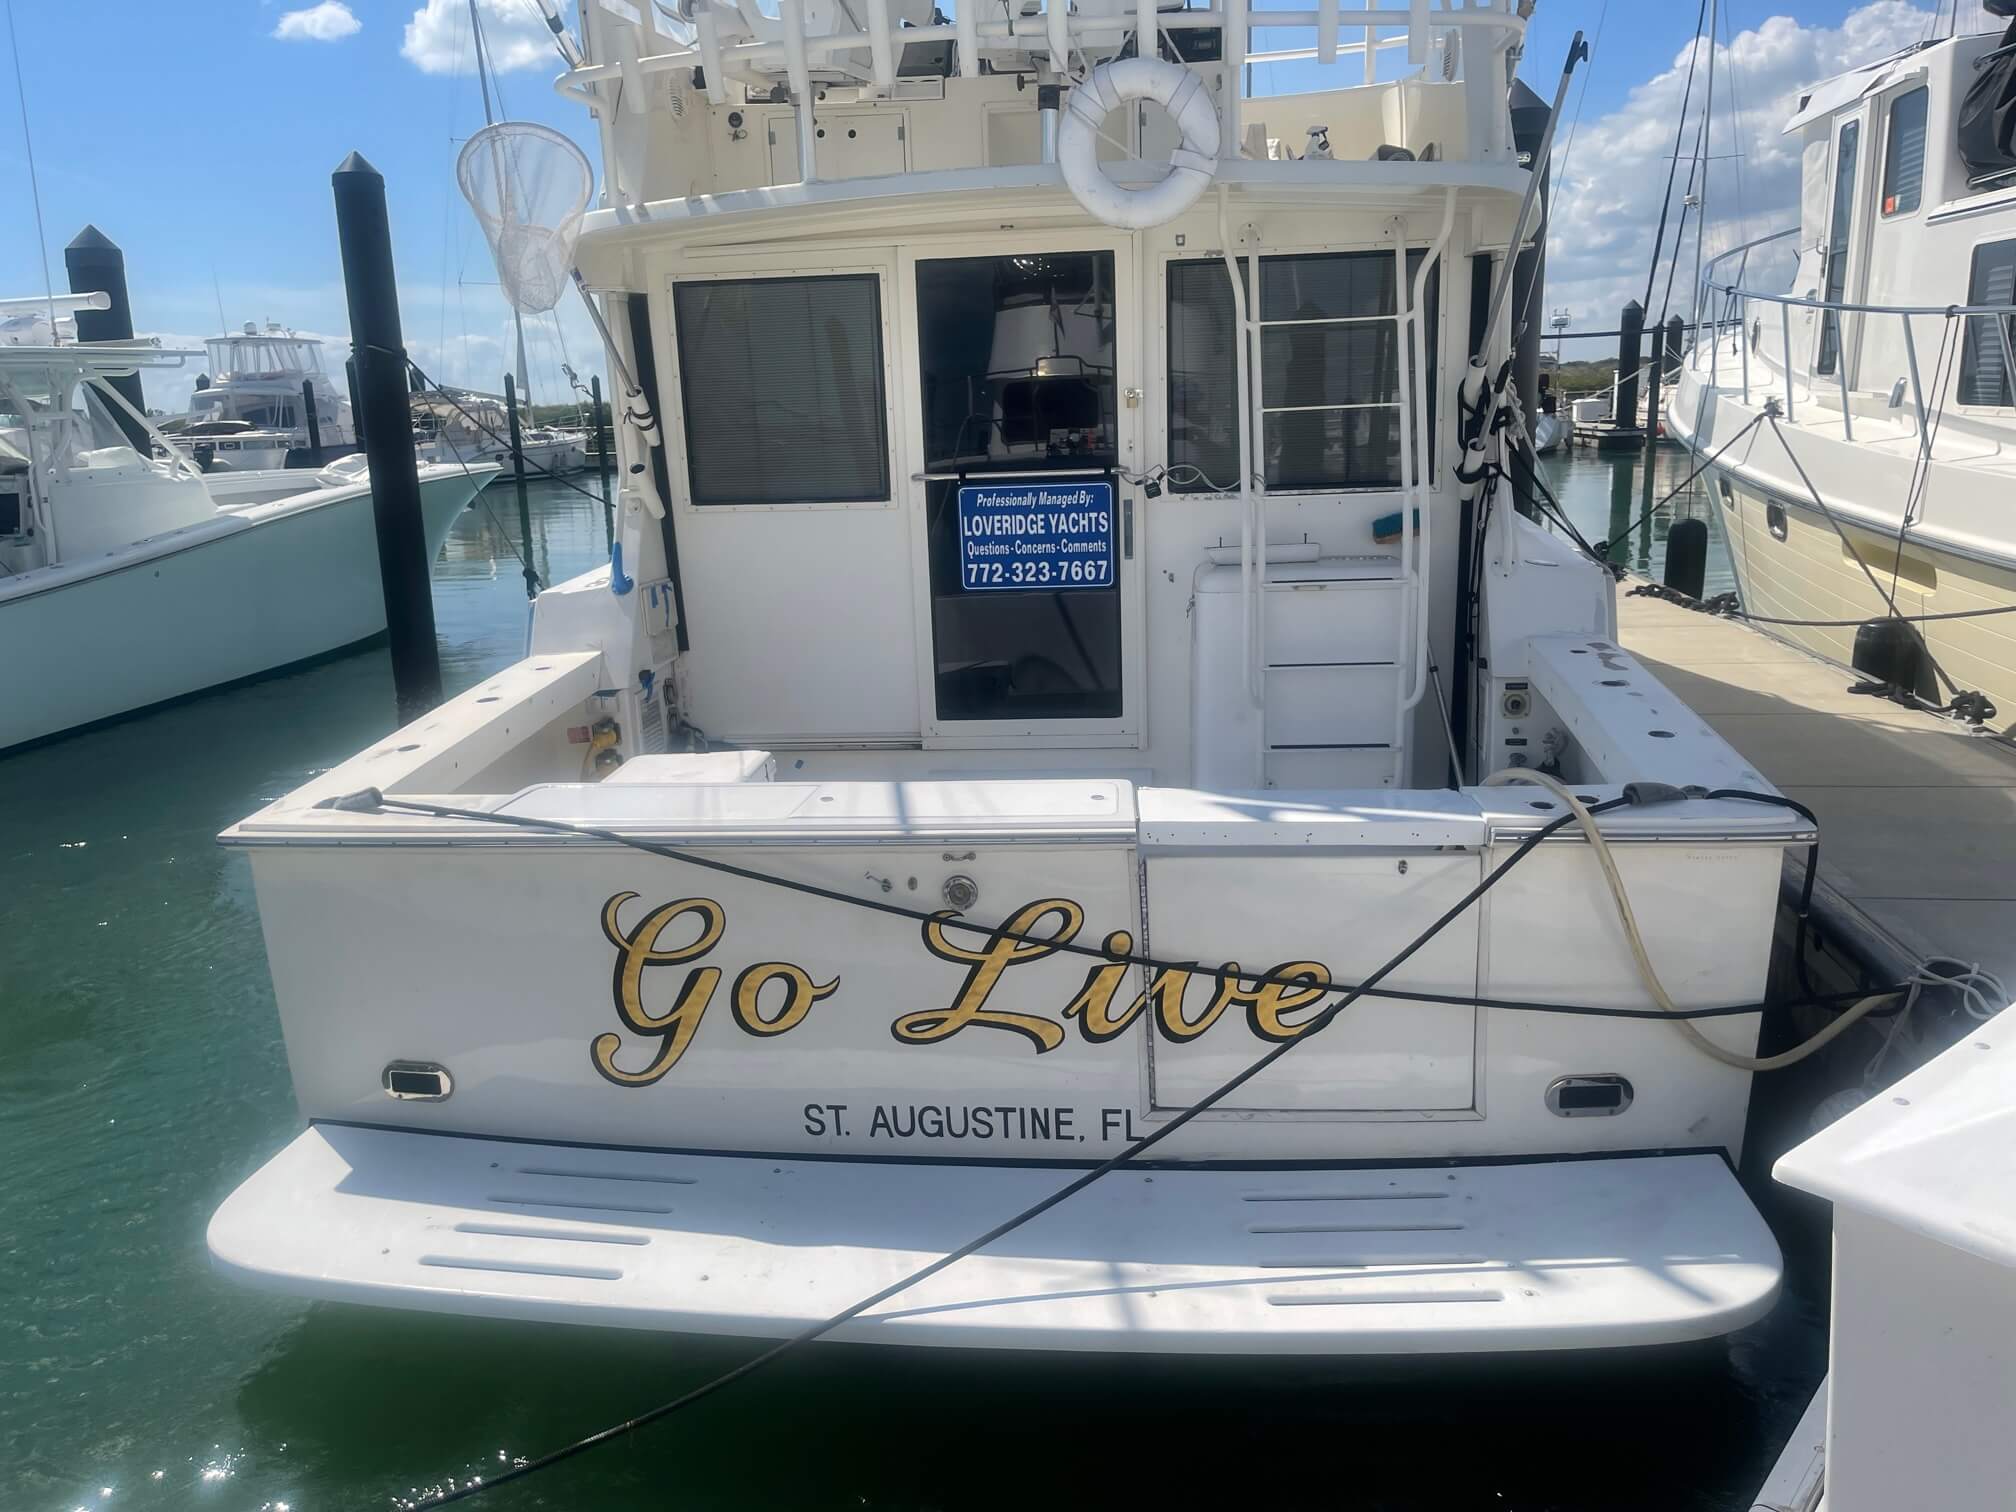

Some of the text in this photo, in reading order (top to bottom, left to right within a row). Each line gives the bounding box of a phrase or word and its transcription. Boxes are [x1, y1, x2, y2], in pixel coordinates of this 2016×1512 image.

[976, 490, 1094, 509] Professionally Managed By:
[963, 512, 1109, 536] LOVERIDGE YACHTS
[967, 560, 1108, 583] 772-323-7667
[590, 891, 1335, 1088] Go Live
[803, 1103, 1146, 1143] ST. AUGUSTINE, FL
